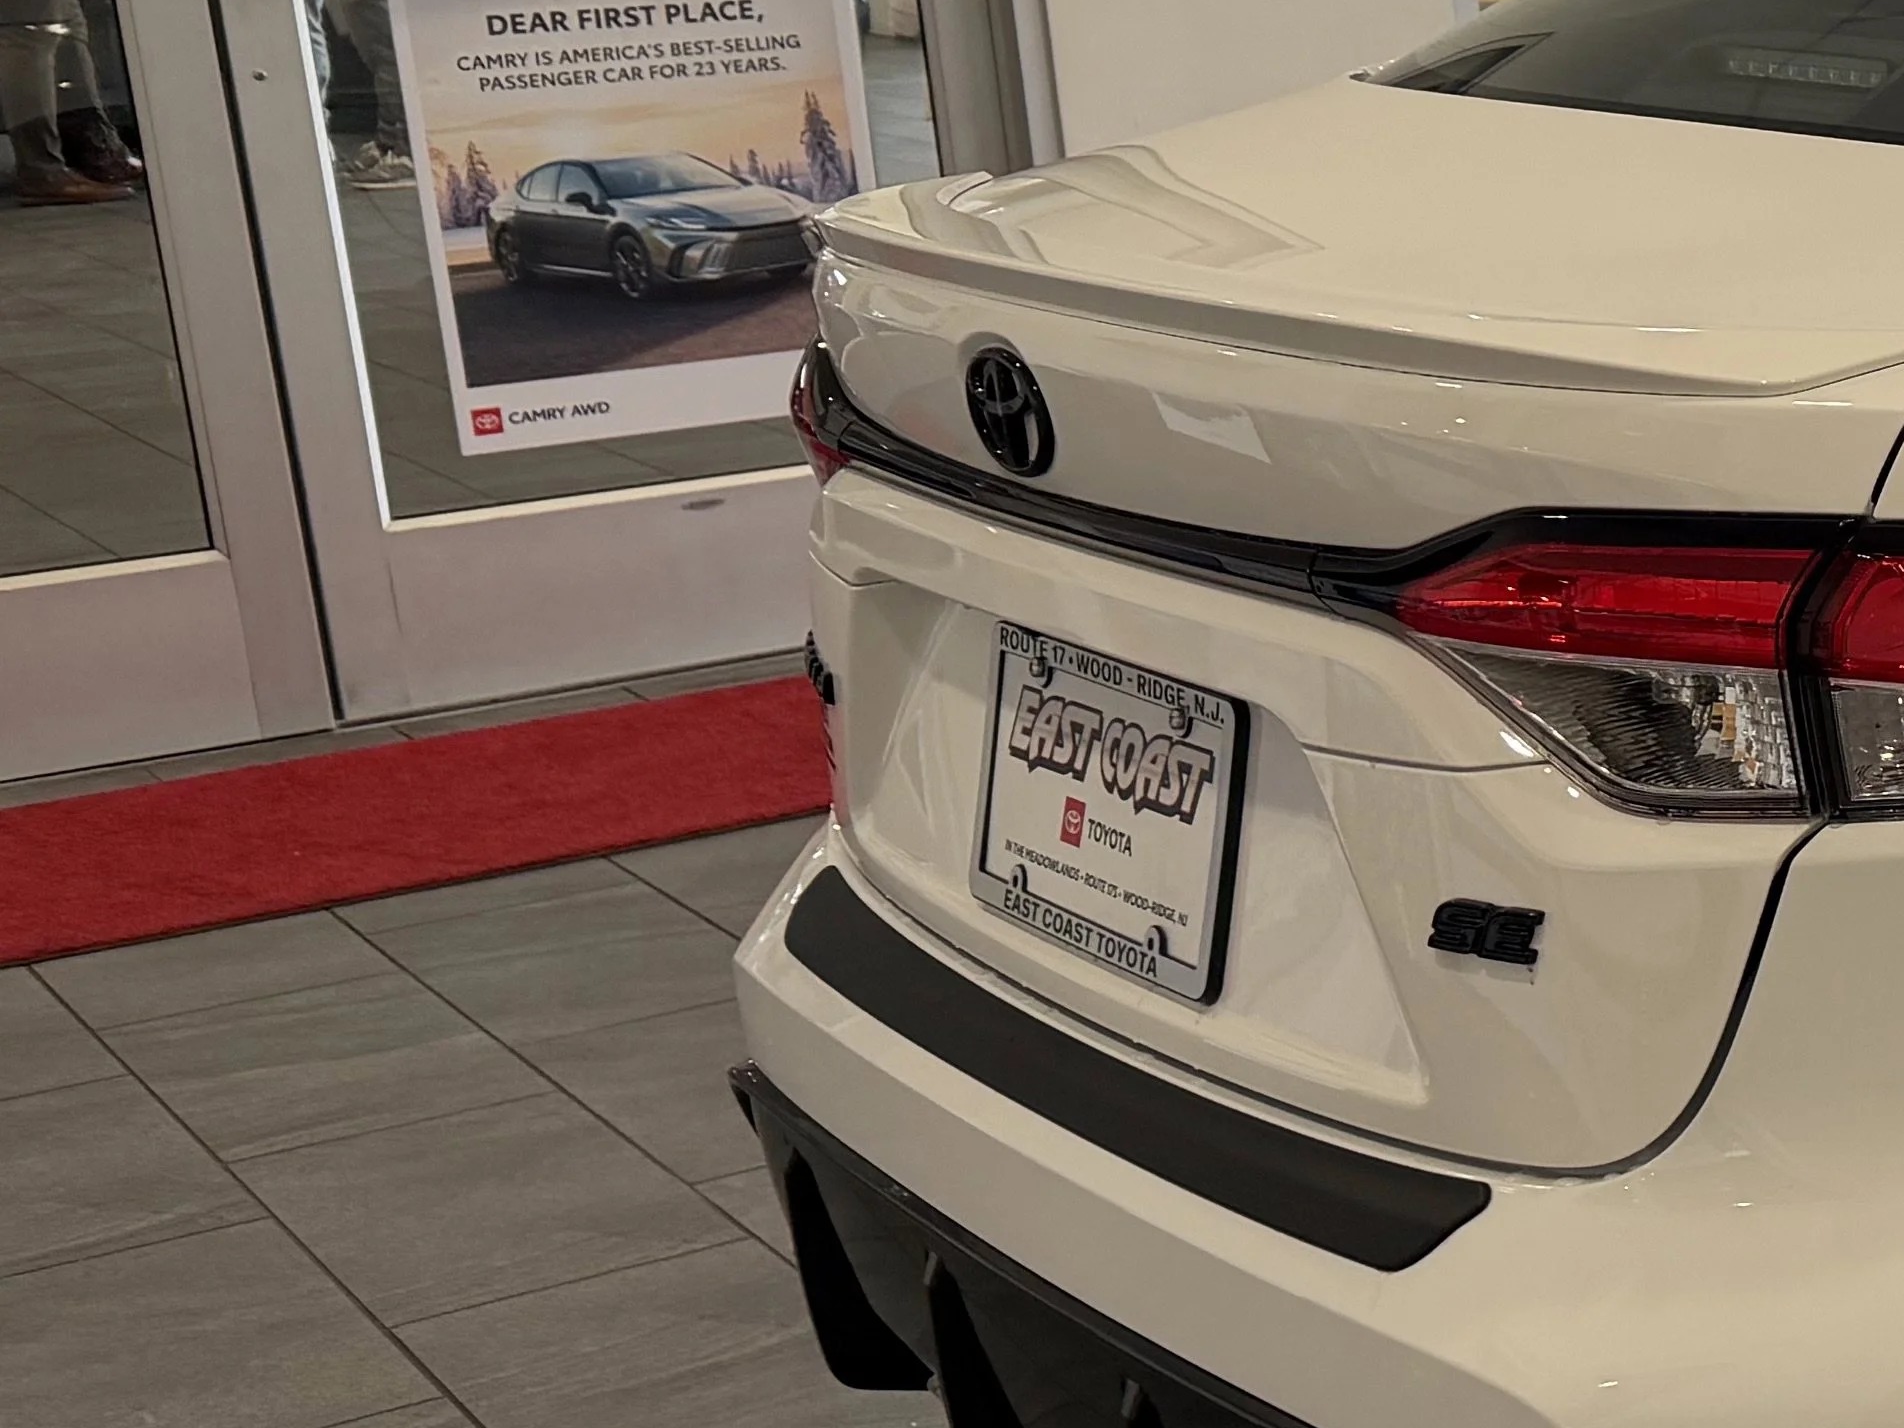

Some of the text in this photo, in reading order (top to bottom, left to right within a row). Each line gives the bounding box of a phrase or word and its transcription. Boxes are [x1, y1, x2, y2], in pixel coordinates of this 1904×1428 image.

[486, 0, 764, 36] DEAR FIRST PLACE,
[456, 34, 802, 72] CAMRY IS AMERICA'S BEST-SELLING
[478, 56, 787, 92] PASSENGER CAR FOR 23 YEARS.
[508, 401, 610, 425] CAMRY AWD
[1000, 626, 1049, 660] ROUTE
[1052, 644, 1066, 664] 17
[1194, 693, 1225, 725] N.J.
[1008, 685, 1216, 825] EAST COAST
[1088, 818, 1132, 857] TOYOTA
[1004, 888, 1159, 978] EAST COAST TOYOTA
